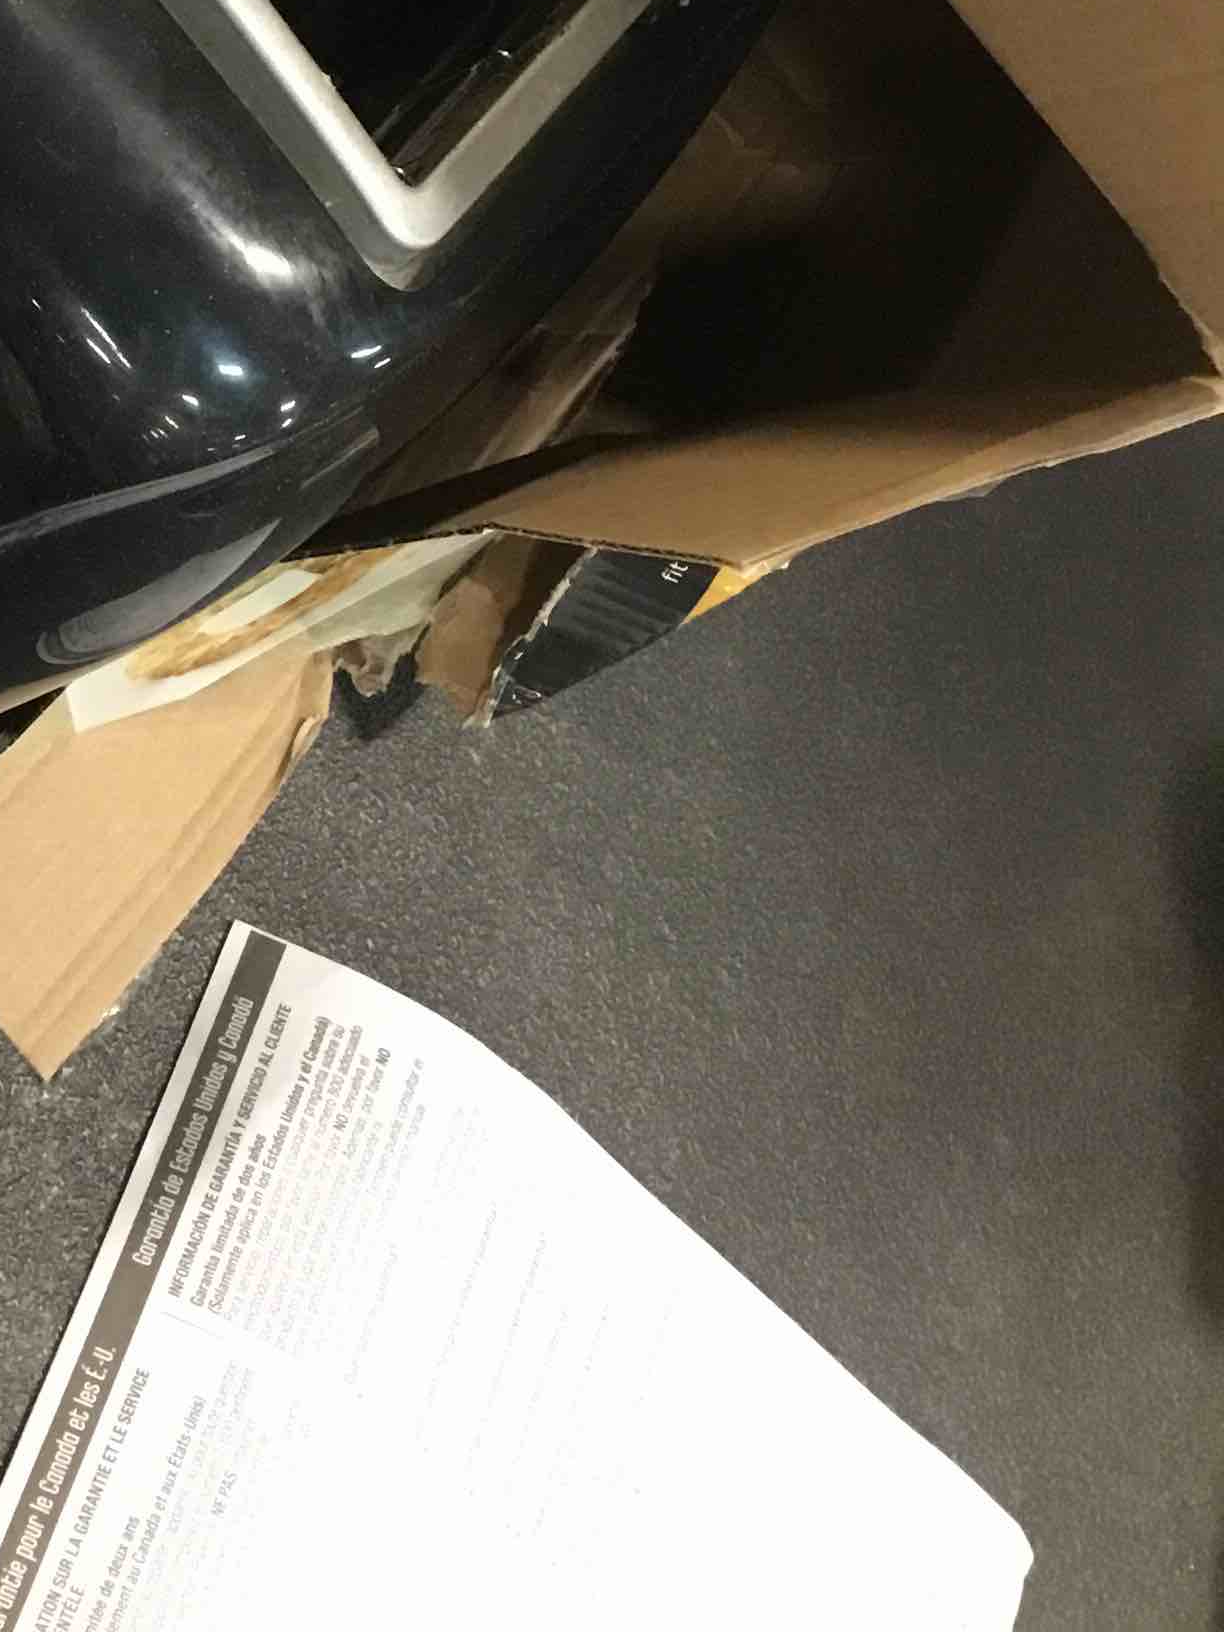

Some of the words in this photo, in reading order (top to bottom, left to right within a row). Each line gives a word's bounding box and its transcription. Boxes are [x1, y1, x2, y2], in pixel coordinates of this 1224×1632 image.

[264, 1003, 292, 1050] CLIENTE
[217, 1050, 237, 1063] y
[258, 1052, 274, 1067] AL
[193, 1061, 228, 1112] Unidos
[237, 1067, 267, 1120] SERVICIO
[280, 1083, 305, 1123] Unidos
[232, 1119, 246, 1129] Y
[168, 1112, 208, 1174] Estados
[262, 1123, 290, 1170] Estados
[161, 1174, 184, 1195] de
[238, 1164, 256, 1186] dos
[254, 1170, 272, 1190] los
[201, 1192, 219, 1211] DE
[231, 1187, 246, 1203] de
[250, 1190, 263, 1207] en
[210, 1204, 240, 1254] limitada
[167, 1210, 212, 1298] INFORMACIÓN
[207, 1245, 243, 1315] (Solamente
[73, 1381, 100, 1408] les
[117, 1367, 150, 1425] SERVICE
[68, 1408, 90, 1431] et
[109, 1425, 128, 1444] LE
[38, 1431, 81, 1495] Canada
[101, 1444, 120, 1464] ET
[29, 1495, 54, 1515] le
[73, 1463, 112, 1535] GARANTIE
[15, 1514, 45, 1562] pour
[64, 1537, 83, 1557] LA
[99, 1579, 115, 1598] de
[122, 1516, 140, 1542] ans
[52, 1558, 73, 1589] SUR
